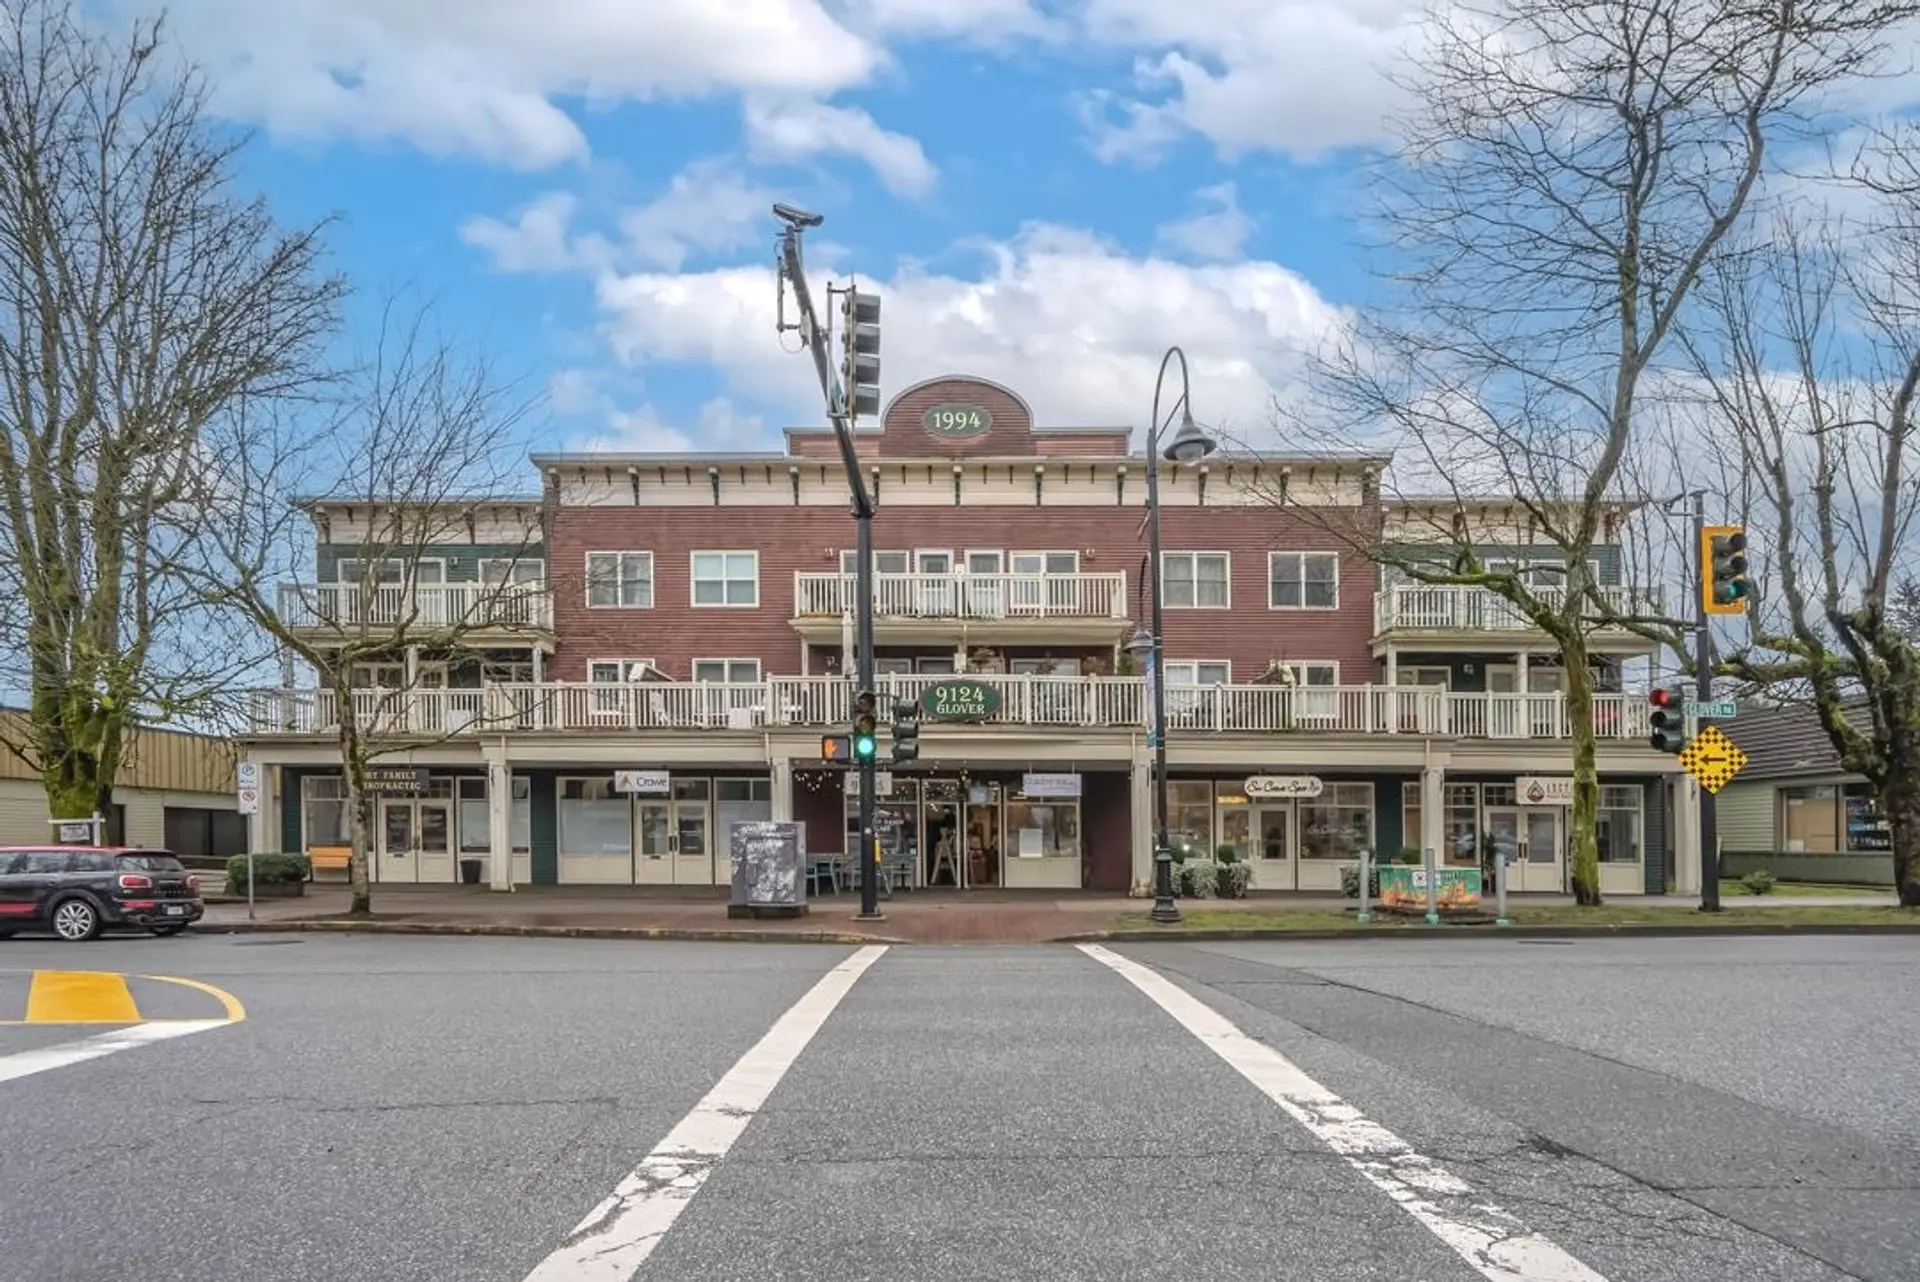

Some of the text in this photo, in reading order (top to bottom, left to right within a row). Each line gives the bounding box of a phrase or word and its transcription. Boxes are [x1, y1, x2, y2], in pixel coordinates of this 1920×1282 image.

[933, 411, 981, 430] 1994
[936, 686, 984, 704] 9124
[936, 703, 985, 714] GLOVER
[383, 771, 417, 780] FAMILY
